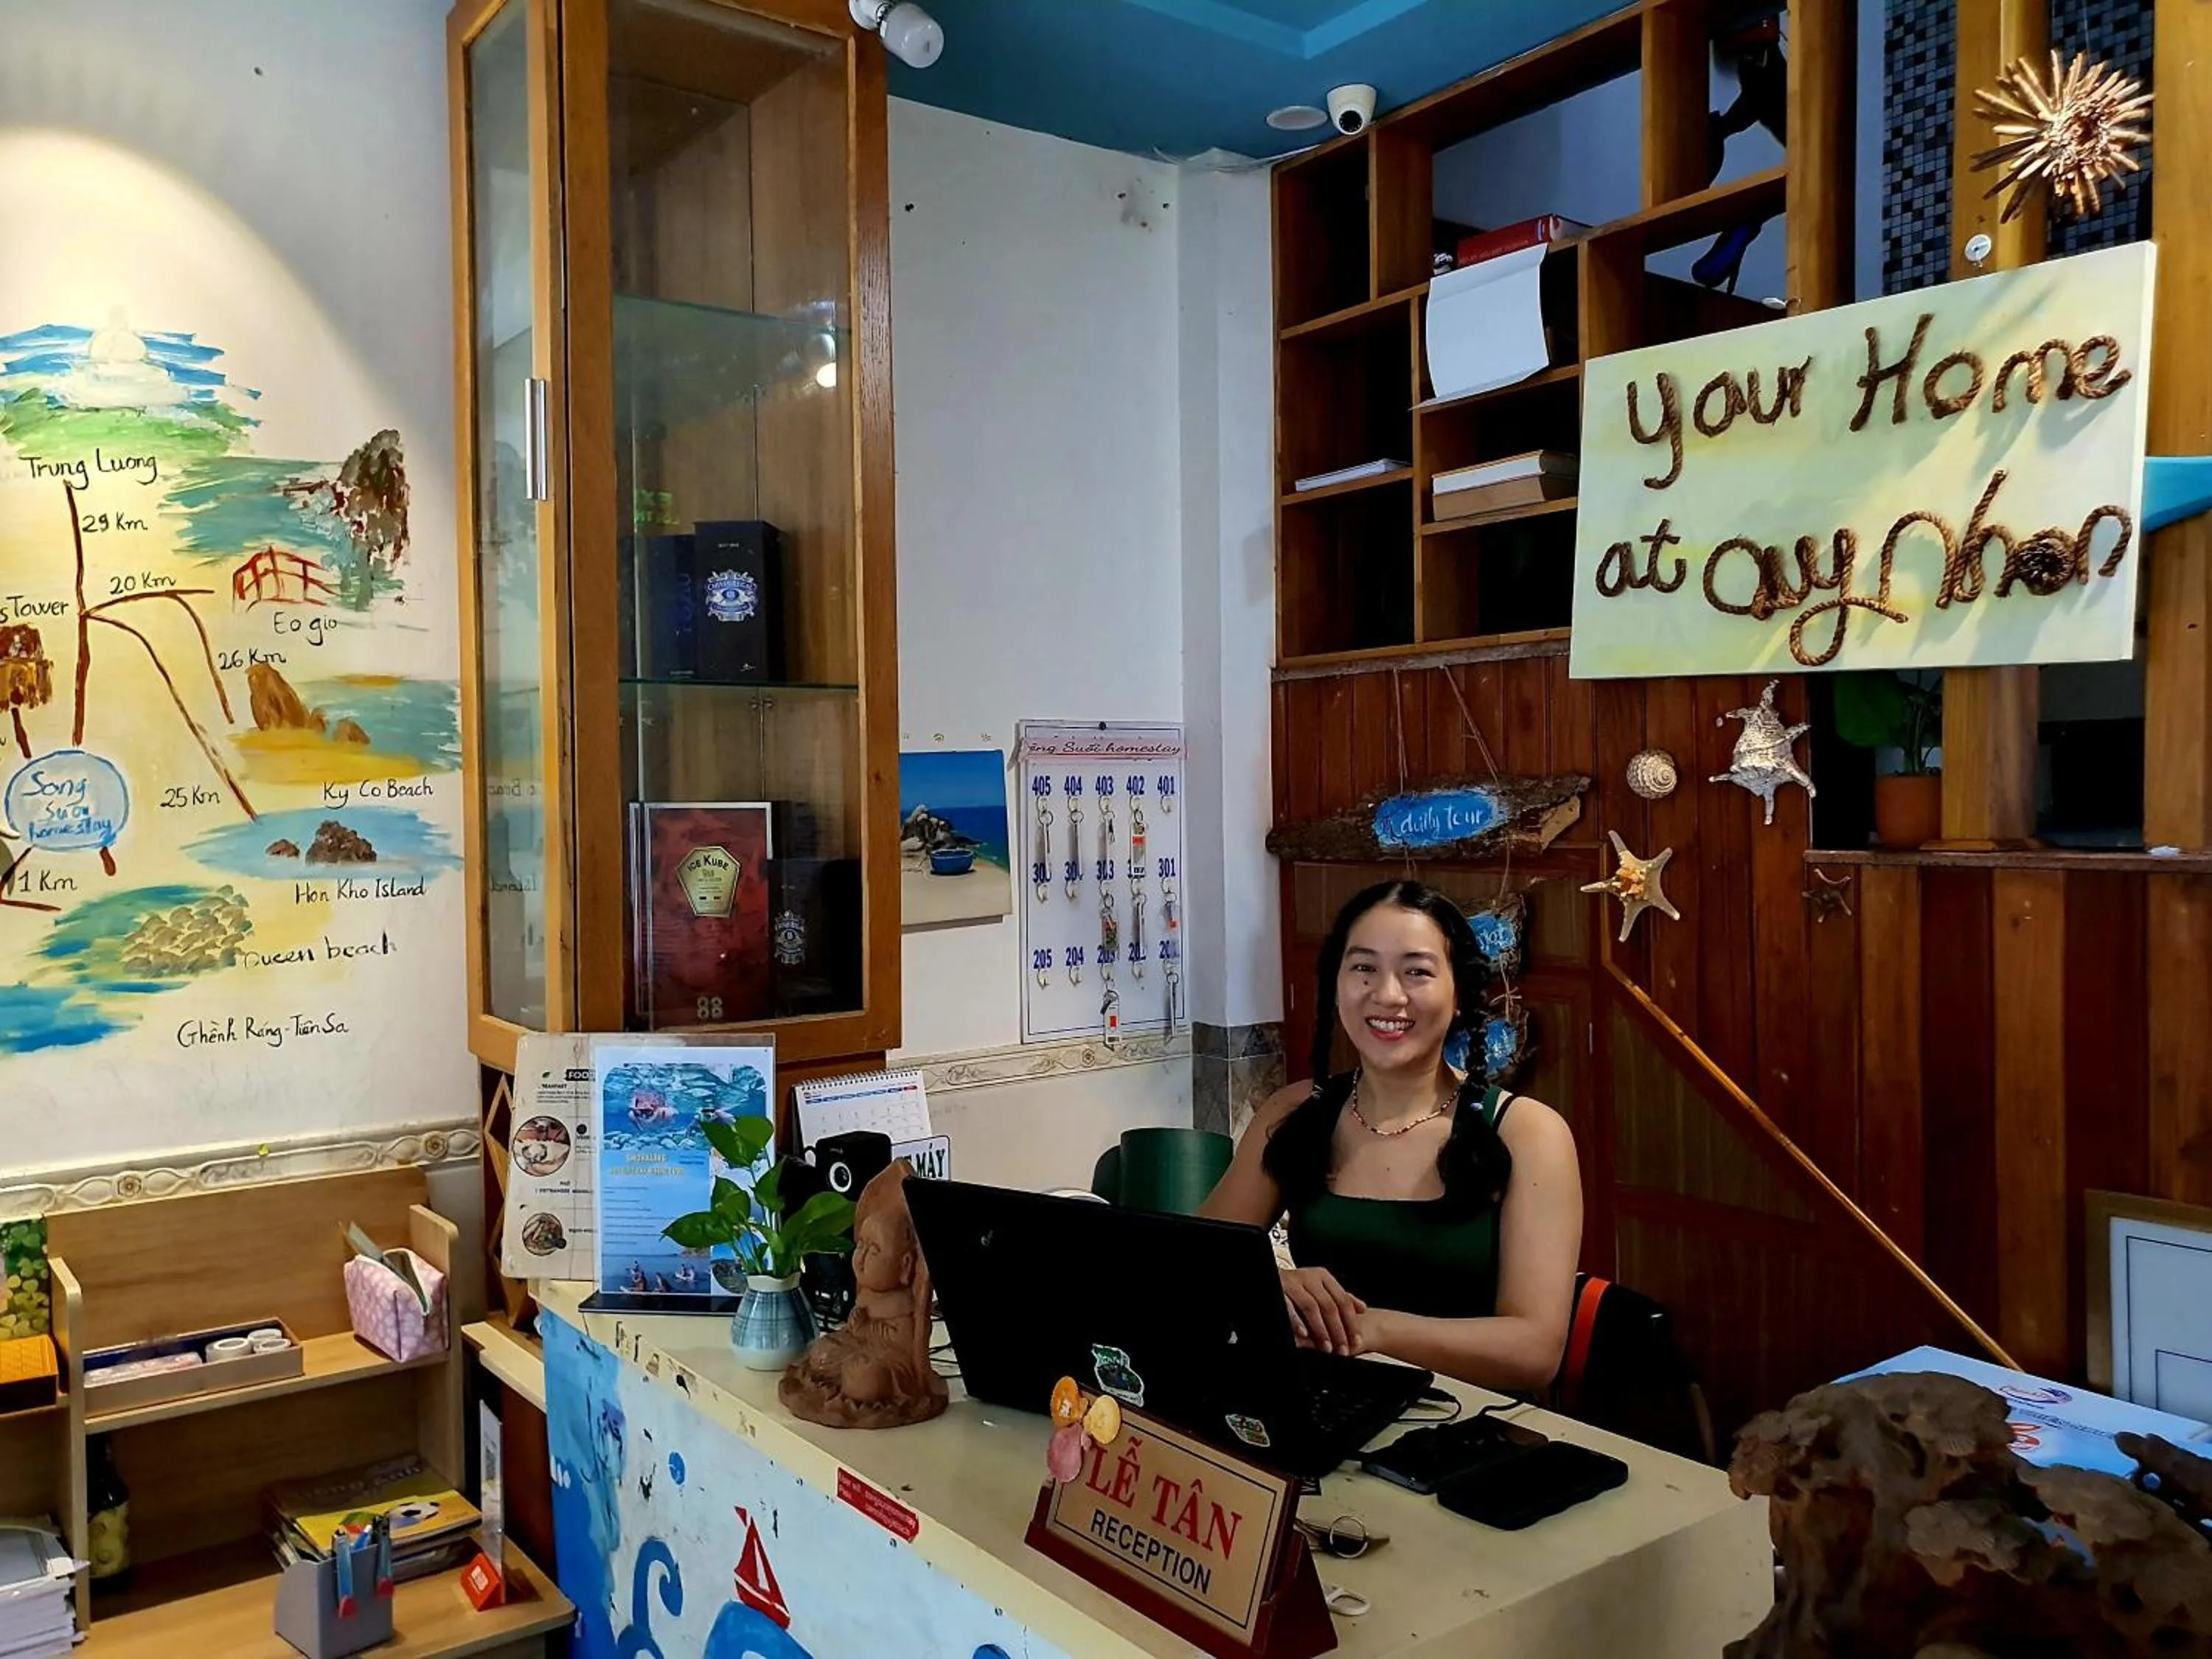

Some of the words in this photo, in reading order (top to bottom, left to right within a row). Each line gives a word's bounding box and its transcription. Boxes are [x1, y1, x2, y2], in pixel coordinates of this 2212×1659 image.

[1627, 355, 1812, 490] your
[1848, 313, 2132, 432] Home
[18, 456, 89, 490] Trung
[97, 448, 157, 486] Luong
[82, 513, 109, 532] 29
[116, 512, 148, 531] Km
[1595, 518, 1687, 598] at
[110, 575, 136, 594] 20
[142, 571, 176, 588] Km
[6, 595, 69, 618] Tower
[274, 611, 302, 634] Eo
[218, 650, 243, 669] 26
[248, 647, 286, 665] Km
[160, 787, 188, 807] 25
[192, 785, 220, 805] Km
[323, 781, 349, 809] Ky
[359, 779, 381, 797] Co
[387, 776, 434, 799] Beach
[1032, 776, 1051, 795] 405
[1064, 776, 1082, 795] 404
[1095, 776, 1114, 795] 403
[1126, 775, 1145, 795] 402
[1157, 775, 1175, 795] 401
[686, 859, 701, 872] ICE
[1158, 858, 1176, 877] 301
[18, 870, 30, 893] 1
[40, 870, 77, 891] Km
[296, 882, 330, 905] Hon
[337, 877, 369, 899] Kho
[376, 875, 425, 898] Island
[1033, 948, 1052, 969] 205
[1065, 947, 1085, 966] 204
[697, 996, 723, 1020] 88
[916, 1142, 946, 1178] MÁY
[1085, 1435, 1142, 1509] LỄ
[1151, 1478, 1243, 1559] TÂN
[1090, 1509, 1211, 1594] RECEPTION
